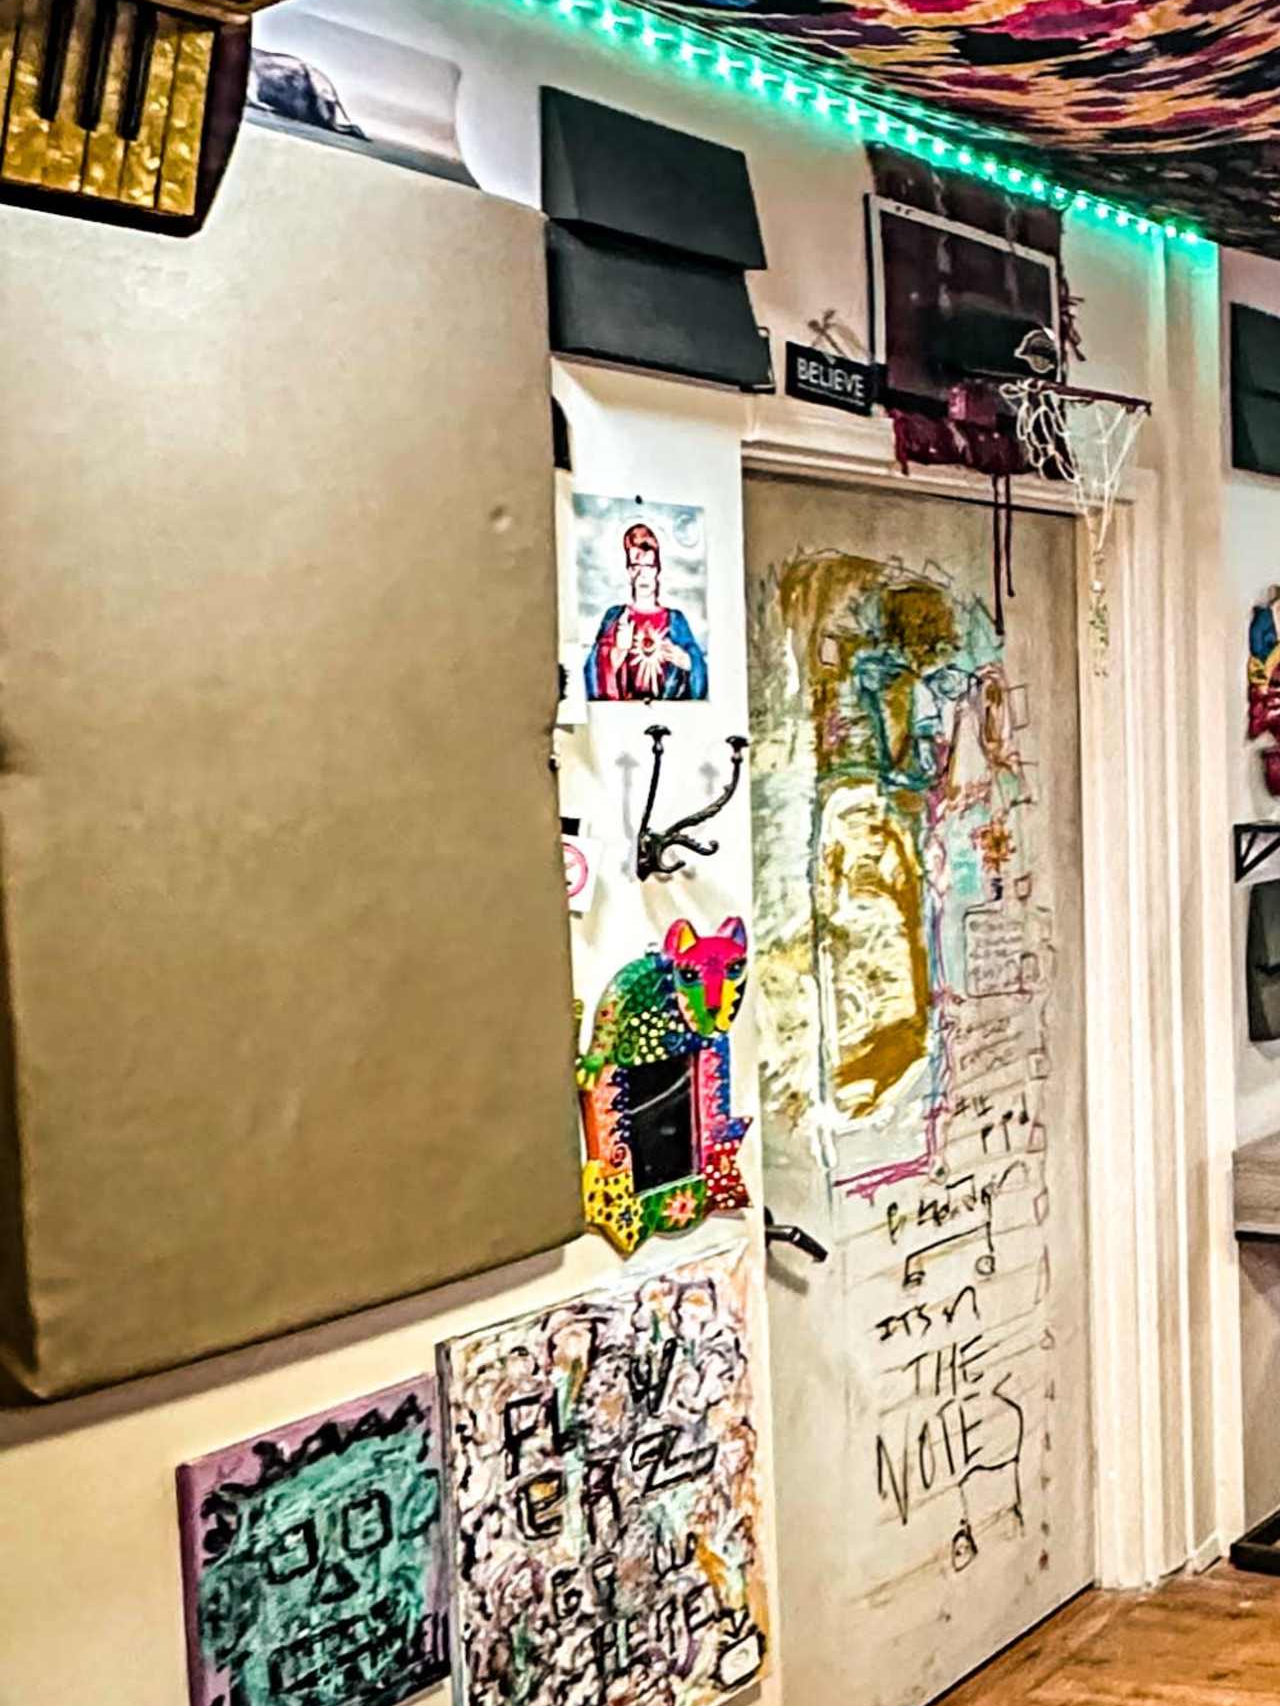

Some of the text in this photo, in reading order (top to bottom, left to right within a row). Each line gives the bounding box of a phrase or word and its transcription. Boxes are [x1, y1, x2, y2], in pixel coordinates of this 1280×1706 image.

[797, 357, 865, 398] BELIEVE
[901, 1334, 984, 1395] THE
[876, 1373, 1024, 1525] NOTES
